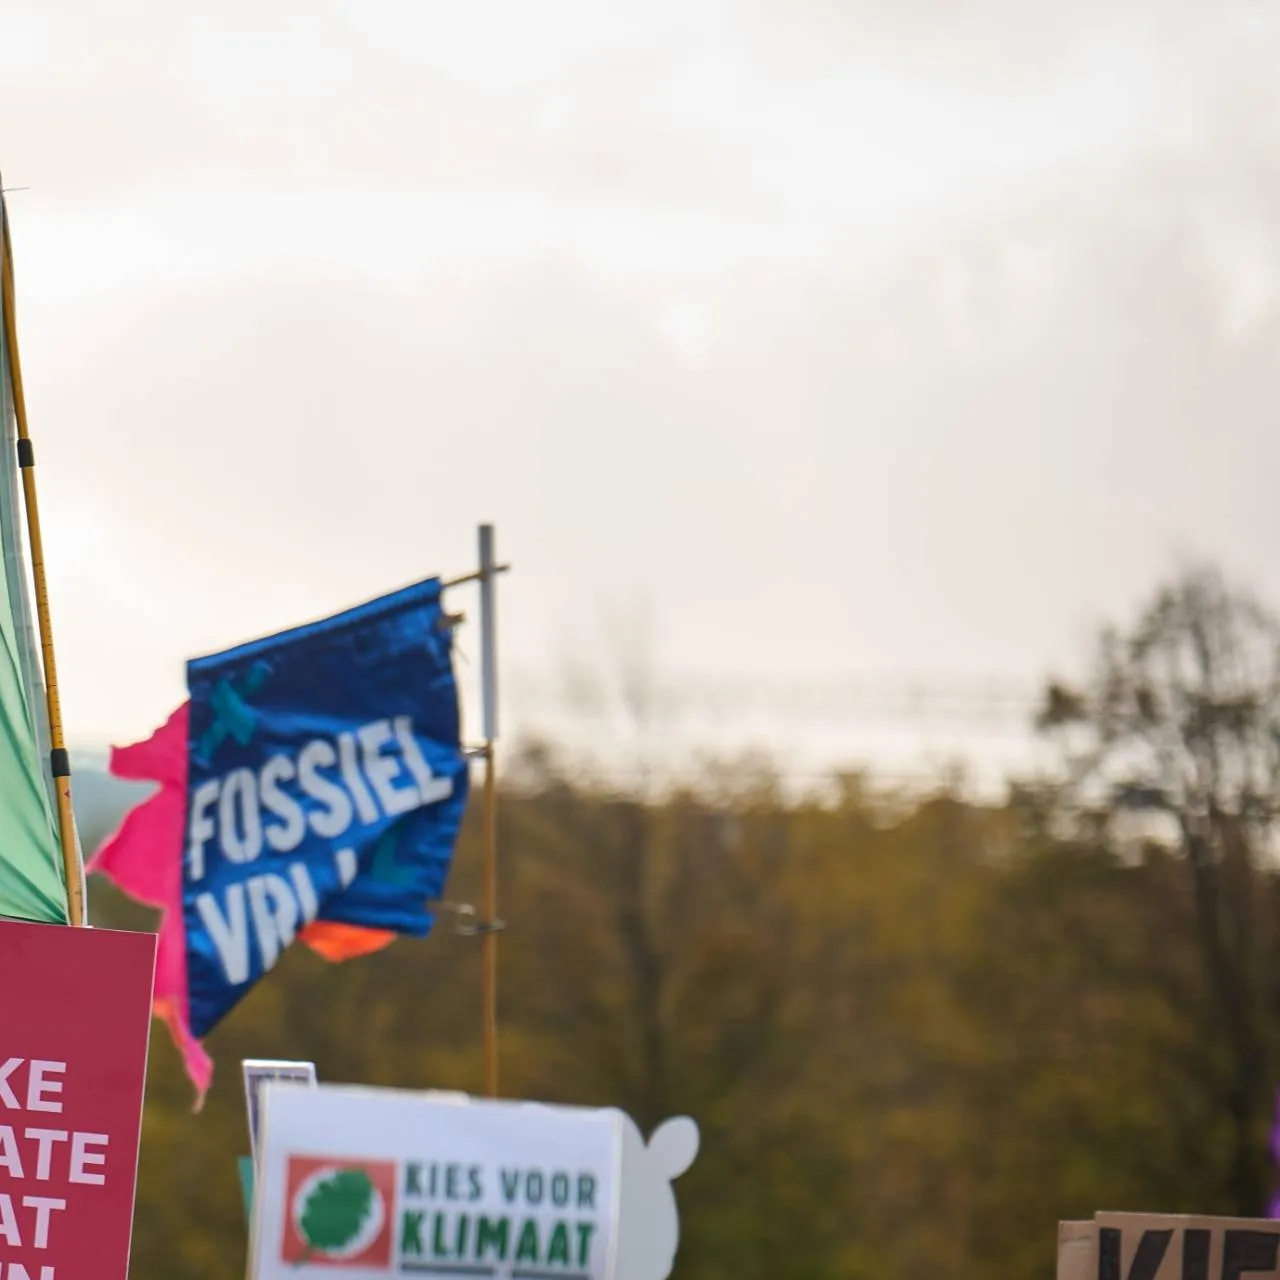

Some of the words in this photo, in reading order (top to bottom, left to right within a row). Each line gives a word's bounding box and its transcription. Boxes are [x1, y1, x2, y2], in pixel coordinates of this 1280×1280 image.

[189, 716, 453, 881] FOSSIEL
[403, 1160, 482, 1201] KIES
[500, 1166, 598, 1211] VOOR
[400, 1208, 598, 1269] KLIMAAT
